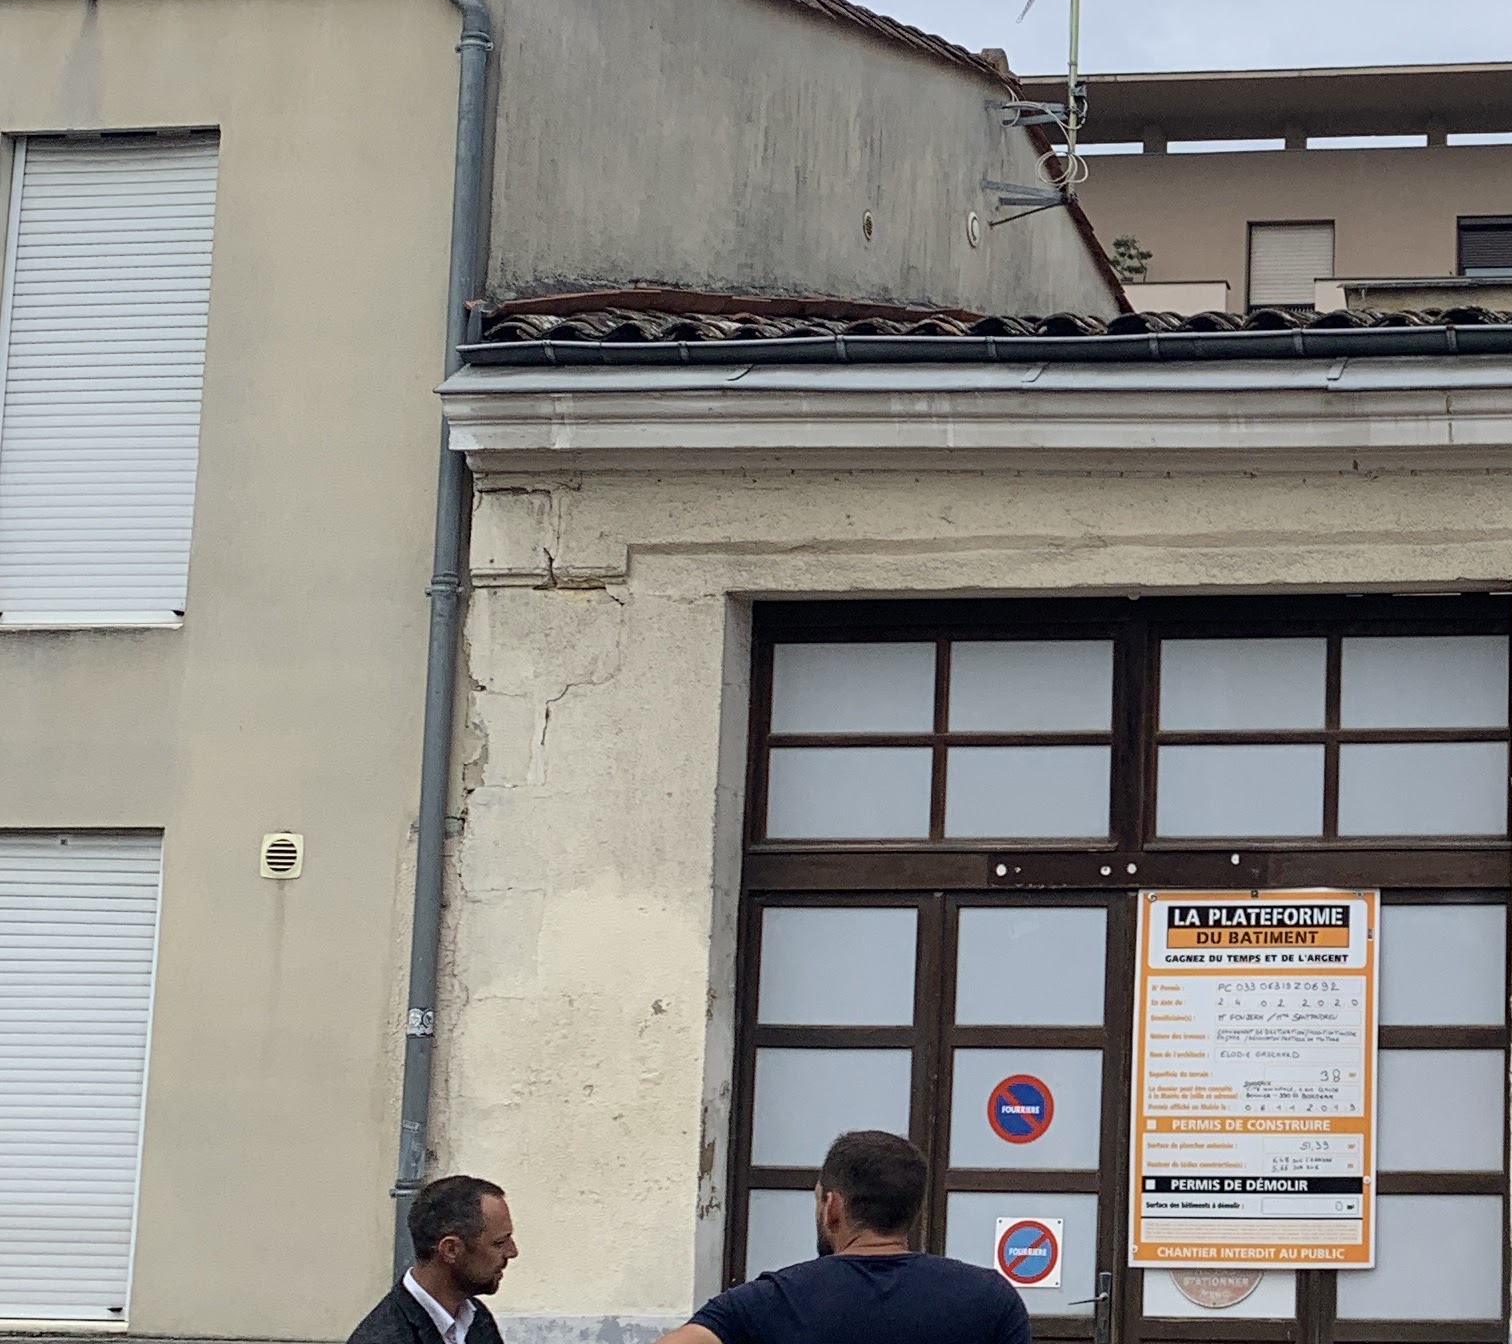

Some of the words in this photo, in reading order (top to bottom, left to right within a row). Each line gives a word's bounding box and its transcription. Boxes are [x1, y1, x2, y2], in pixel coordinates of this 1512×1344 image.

[1174, 908, 1200, 926] LA
[1208, 907, 1344, 926] PLATEFORME
[1196, 931, 1222, 944] DU
[1228, 931, 1318, 944] BATIMENT
[1165, 954, 1205, 963] GAGNEZ
[1209, 954, 1222, 963] DU
[1227, 954, 1261, 963] TEMPS
[1265, 954, 1276, 963] ET
[1281, 954, 1294, 963] DE
[1298, 954, 1349, 963] L'ARGENT
[1001, 1105, 1040, 1114] FOURRIERE
[1172, 1120, 1222, 1131] PERMIS
[1225, 1120, 1244, 1131] DE
[1247, 1120, 1332, 1131] CONSTRUIRE
[1170, 1180, 1220, 1191] PERMIS
[1224, 1180, 1243, 1191] DE
[1246, 1178, 1308, 1191] DÉMOLIR
[1157, 1246, 1217, 1258] CHANTIER
[1221, 1247, 1276, 1259] INTERDIT
[1279, 1248, 1297, 1259] AU
[1301, 1248, 1345, 1259] PUBLIC
